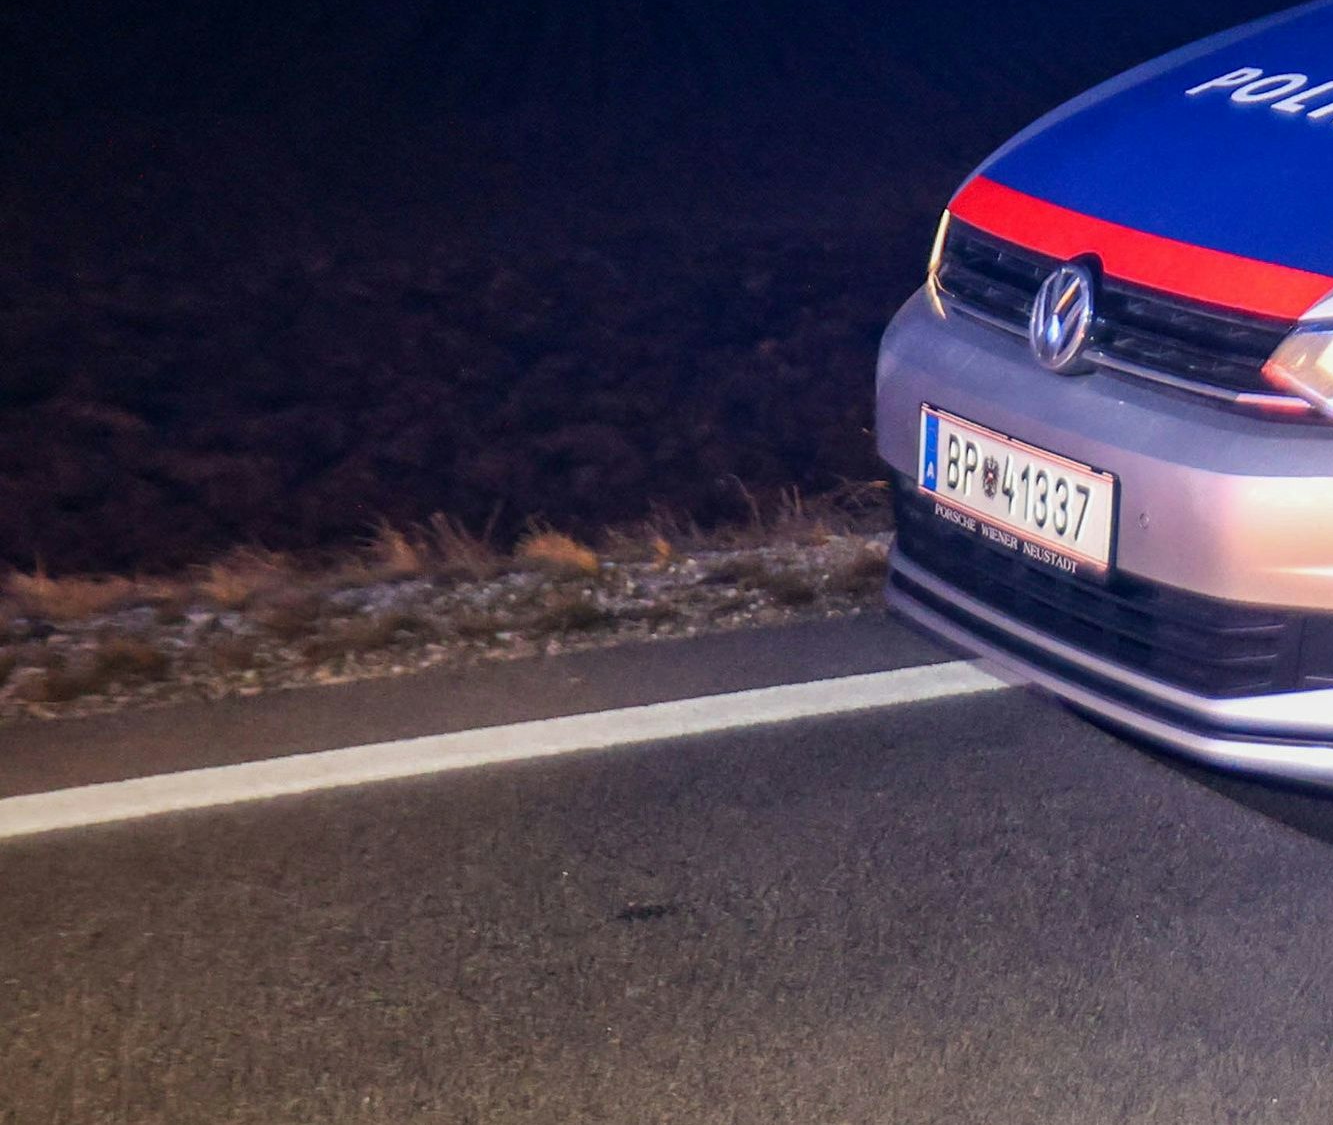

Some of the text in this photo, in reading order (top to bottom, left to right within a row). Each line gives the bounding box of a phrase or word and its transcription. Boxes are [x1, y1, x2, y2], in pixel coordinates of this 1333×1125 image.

[947, 433, 1092, 542] BP 41337
[935, 503, 1078, 574] PORSCHE WIENER NEUSTADT
